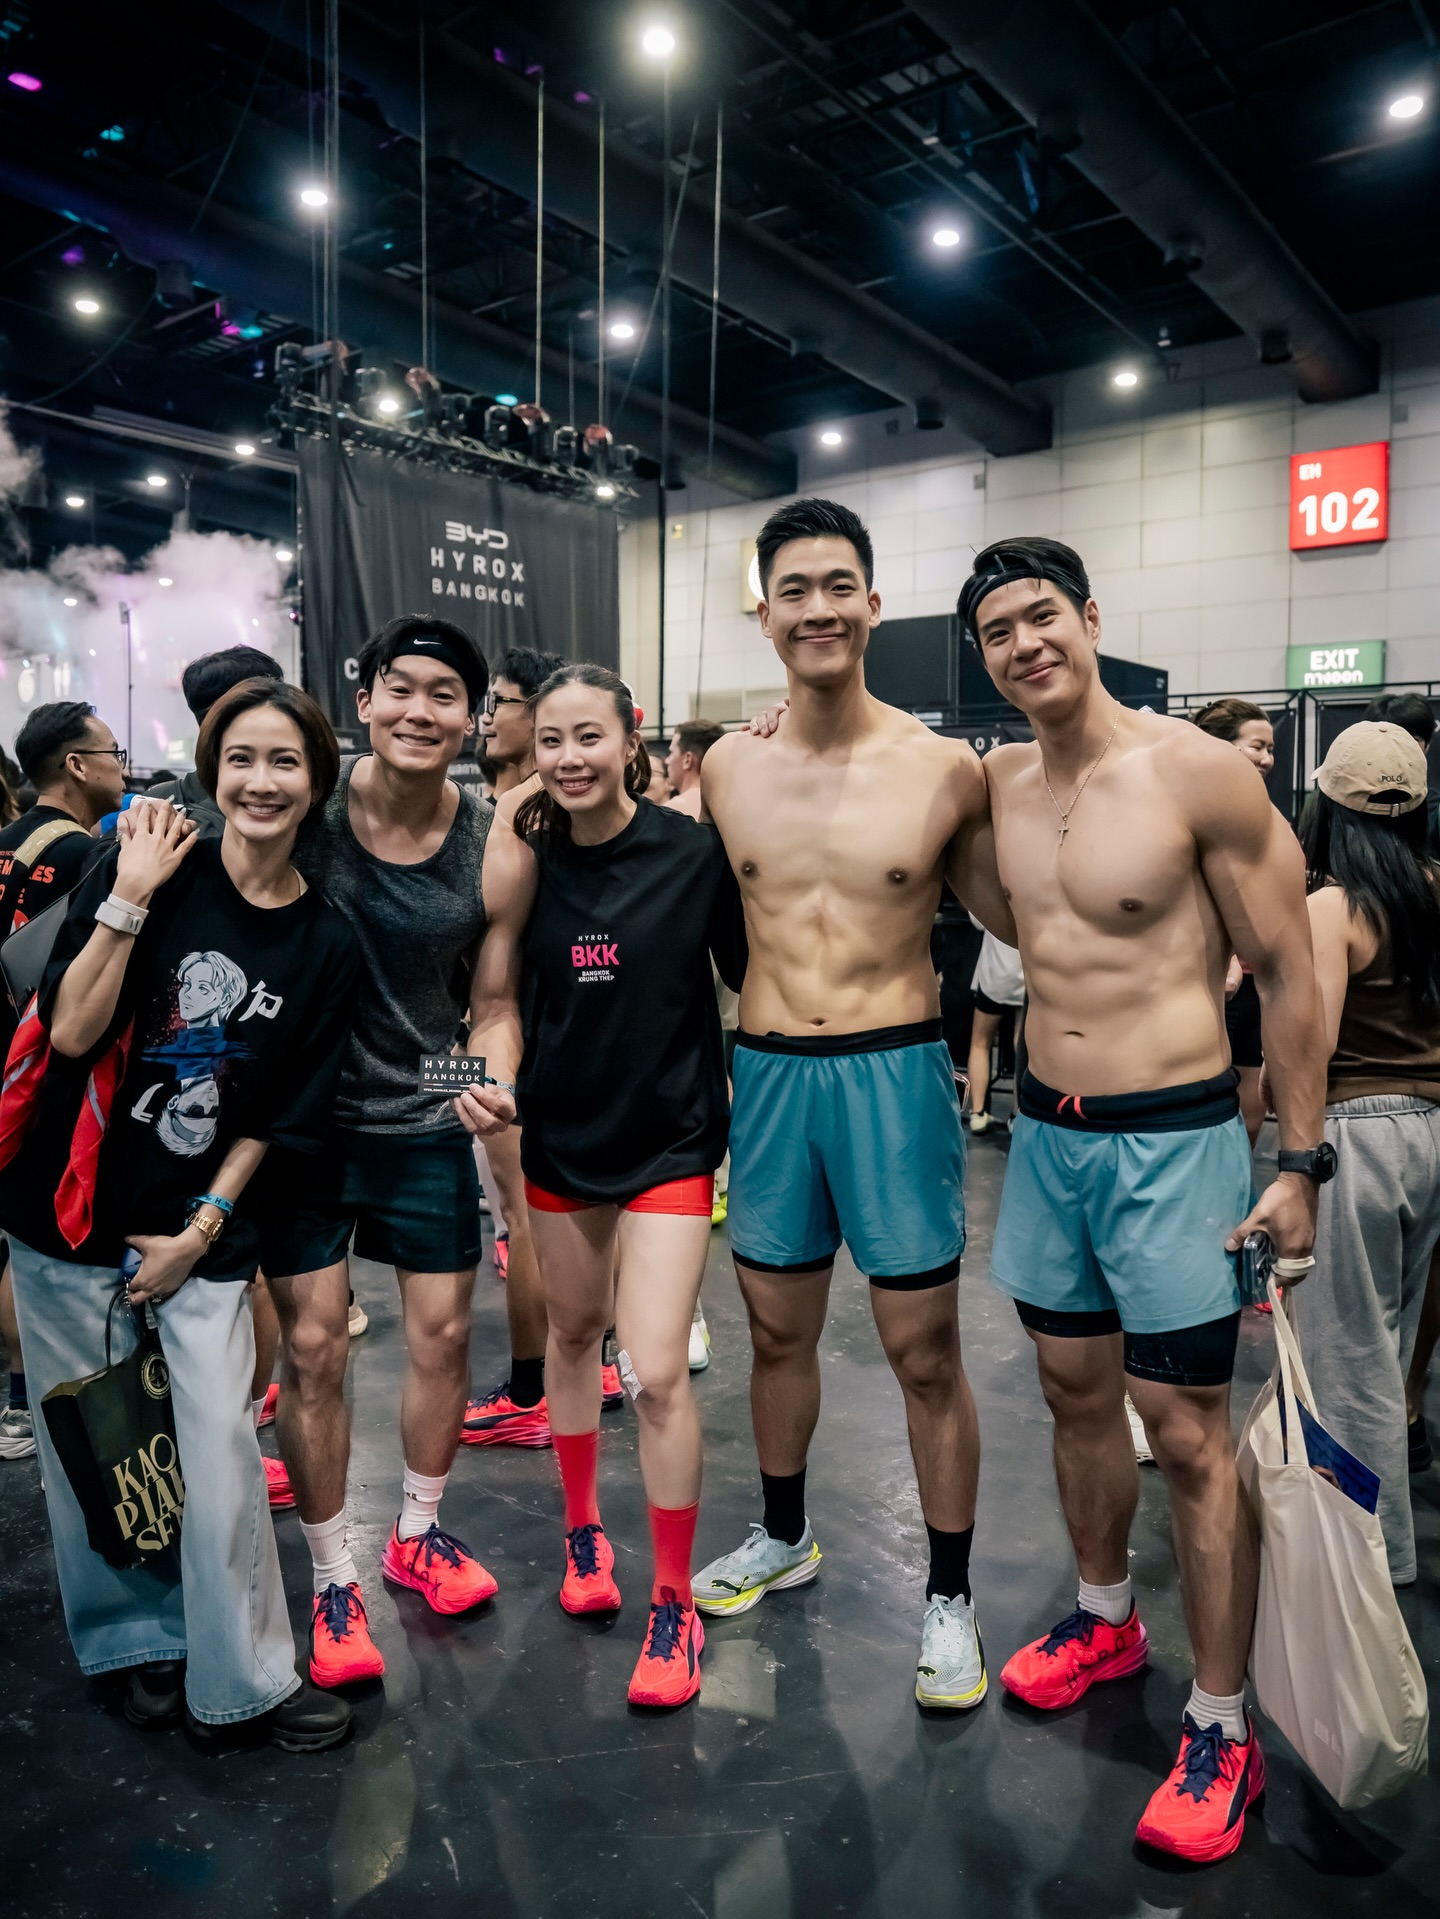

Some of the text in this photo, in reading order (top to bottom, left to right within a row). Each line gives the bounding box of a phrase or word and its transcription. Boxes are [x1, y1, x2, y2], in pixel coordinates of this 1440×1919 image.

[1299, 462, 1322, 481] EH
[1298, 487, 1380, 536] 102
[445, 520, 509, 550] BYD
[430, 546, 525, 583] HYROX
[431, 577, 525, 608] BANGKOK
[1309, 648, 1360, 671] EXIT
[1381, 775, 1403, 783] POLO
[578, 933, 609, 942] HYROX
[571, 943, 620, 967] BKK
[581, 969, 610, 977] BANGKOK
[424, 1060, 481, 1071] HYROX
[424, 1072, 480, 1082] BANGKOK
[112, 1433, 177, 1502] KAO
